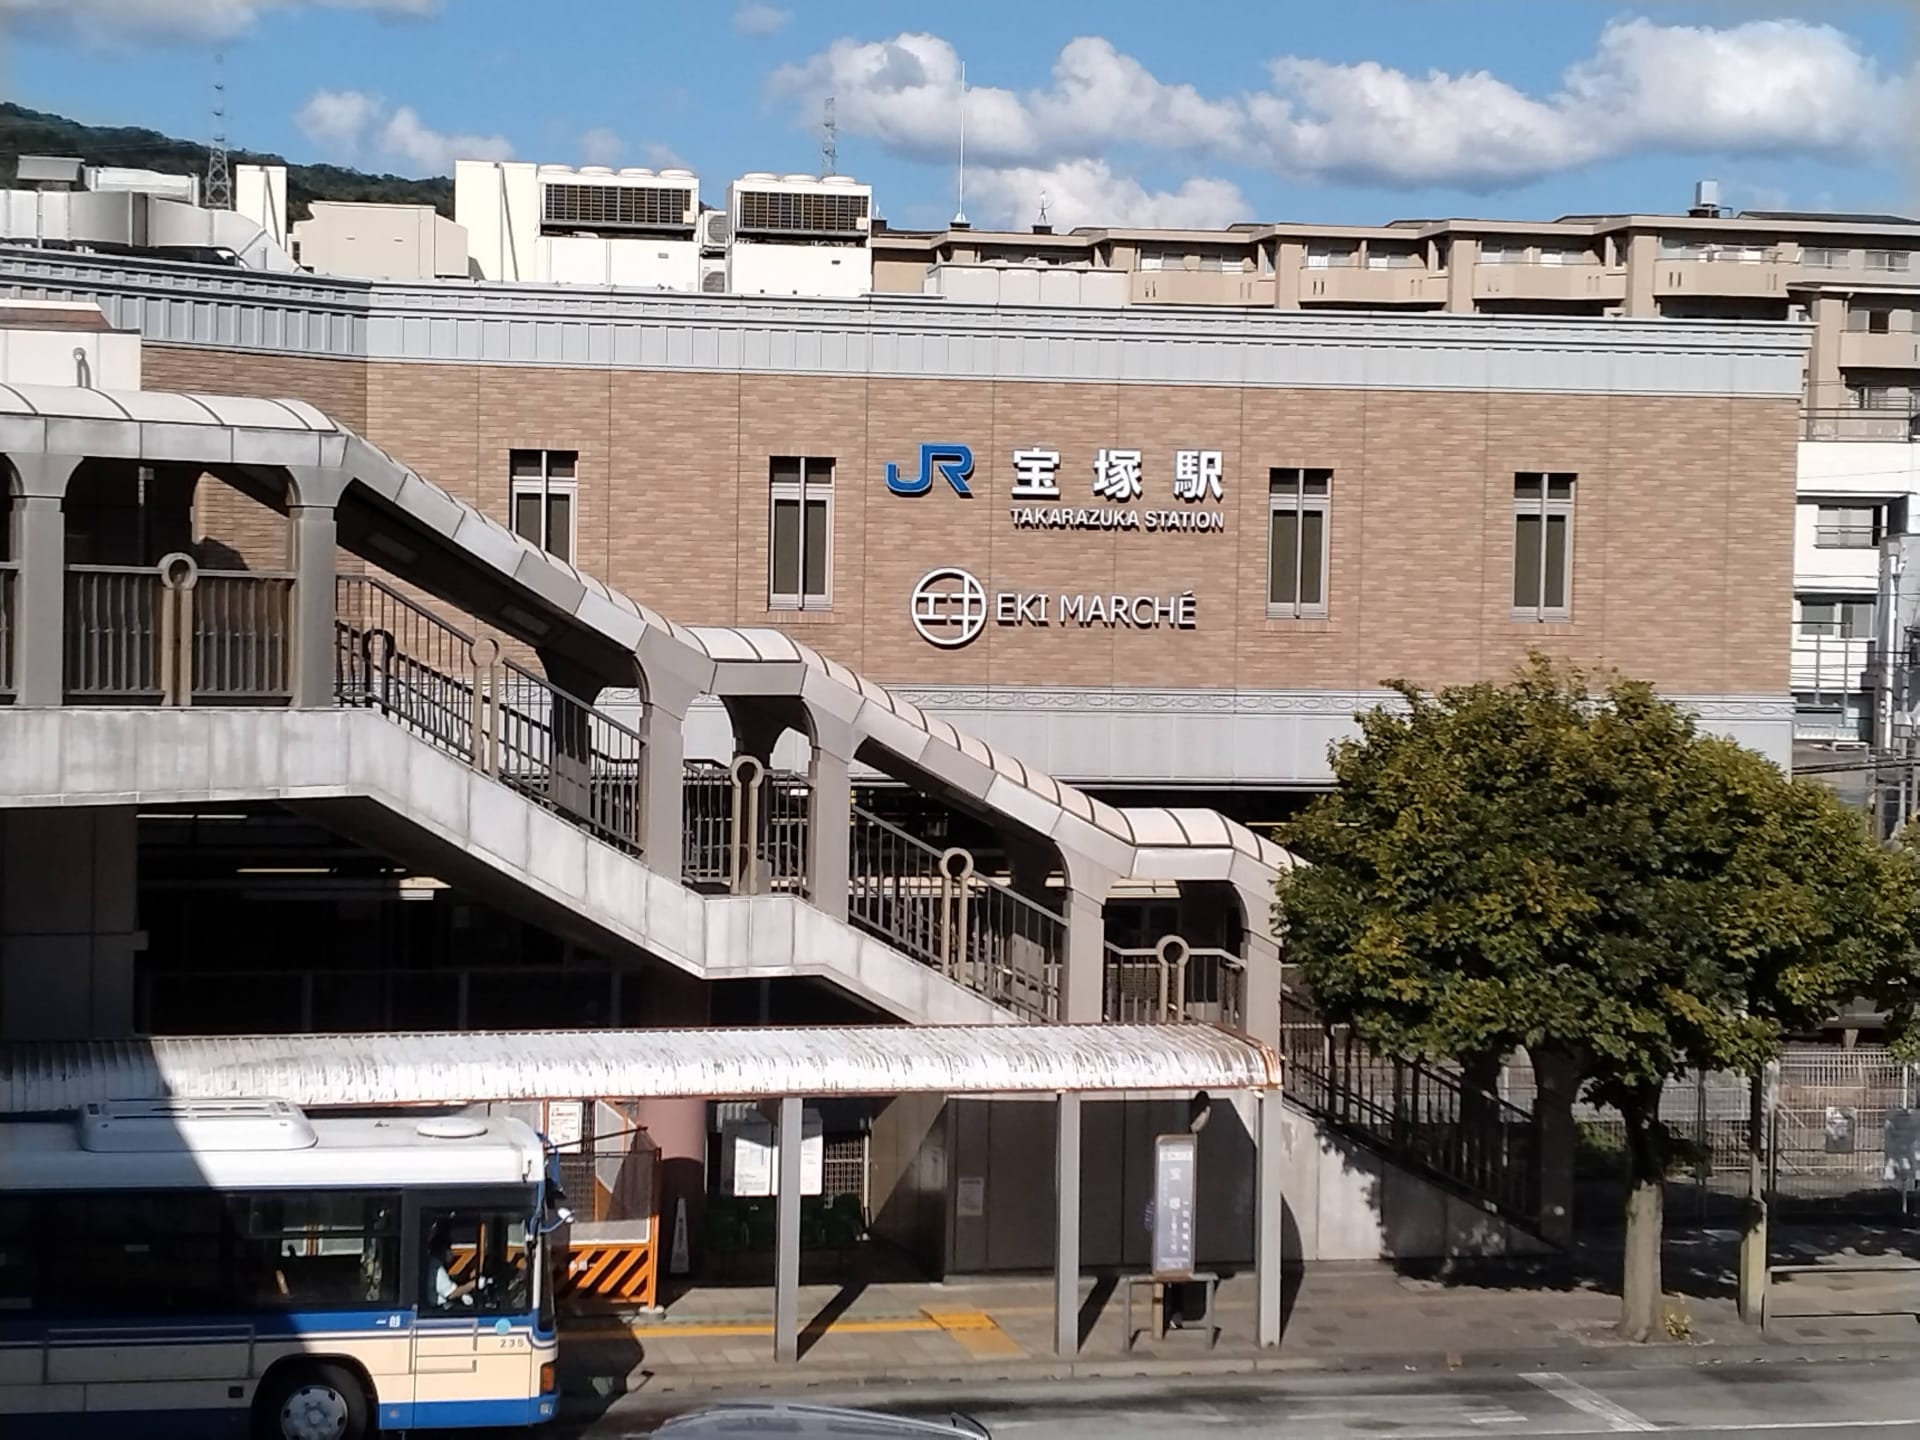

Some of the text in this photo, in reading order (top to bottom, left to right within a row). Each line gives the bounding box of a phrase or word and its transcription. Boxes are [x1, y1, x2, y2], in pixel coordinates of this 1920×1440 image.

[885, 442, 974, 496] JR
[1011, 447, 1224, 500] 宝塚駅
[1011, 507, 1224, 530] TAKARAZUKA STATION
[996, 590, 1197, 627] EKI MARCHÉ
